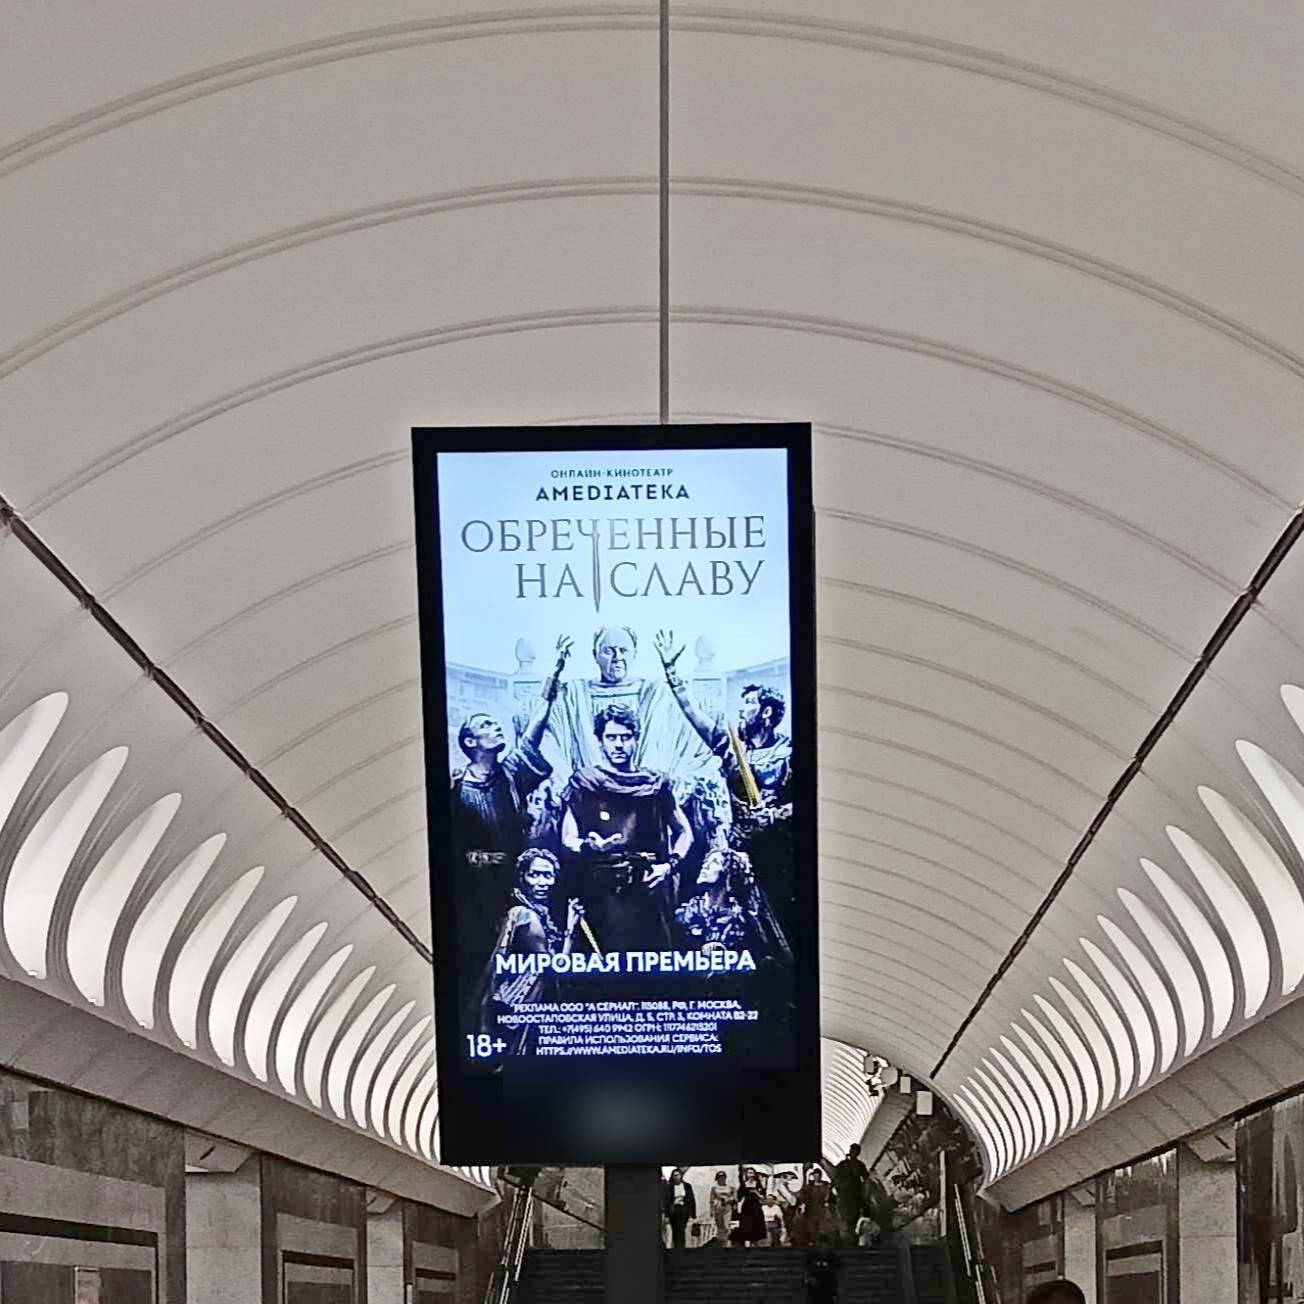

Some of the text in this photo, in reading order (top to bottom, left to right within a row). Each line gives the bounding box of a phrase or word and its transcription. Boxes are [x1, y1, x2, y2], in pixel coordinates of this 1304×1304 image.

[535, 484, 690, 502] AMEDIATEKA
[460, 515, 767, 554] ОБРЕЧЕННЫЕ
[515, 559, 765, 600] НА СЛАВУ
[495, 949, 757, 975] МИРОВАЯ ПРЕМЬЕРА
[514, 1002, 559, 1013] РЕКЛАМА
[560, 1002, 583, 1012] ООО
[686, 1011, 732, 1021] КОМНАТА
[466, 1034, 507, 1057] 18+
[538, 1035, 583, 1045] ПРАВИЛА
[585, 1034, 670, 1044] ИСПОЛЬЗОВАНИЯ
